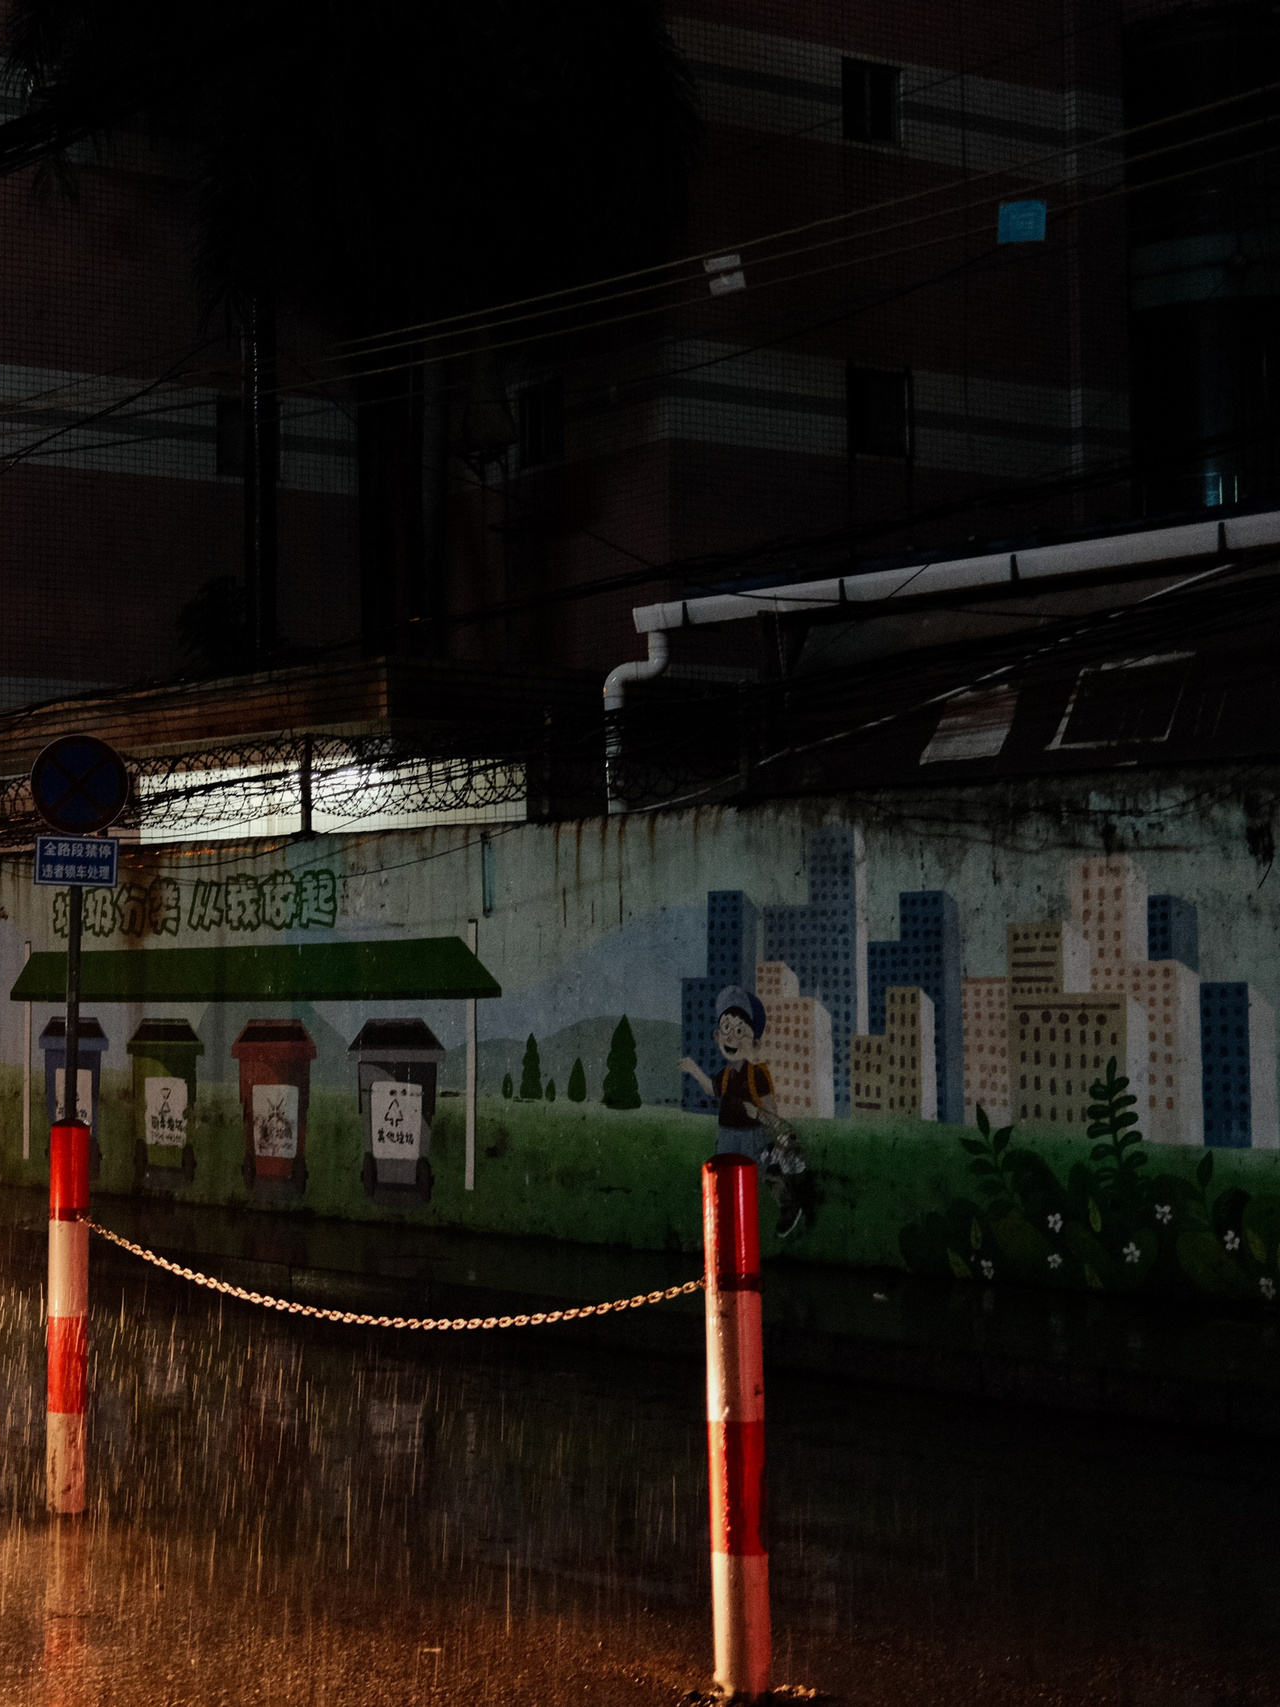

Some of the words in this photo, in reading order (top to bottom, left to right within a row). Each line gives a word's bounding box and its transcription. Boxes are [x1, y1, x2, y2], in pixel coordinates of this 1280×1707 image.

[44, 842, 112, 858] 全路段禁停
[42, 864, 110, 880] 违者锁车处理
[187, 868, 337, 932] 从我做起
